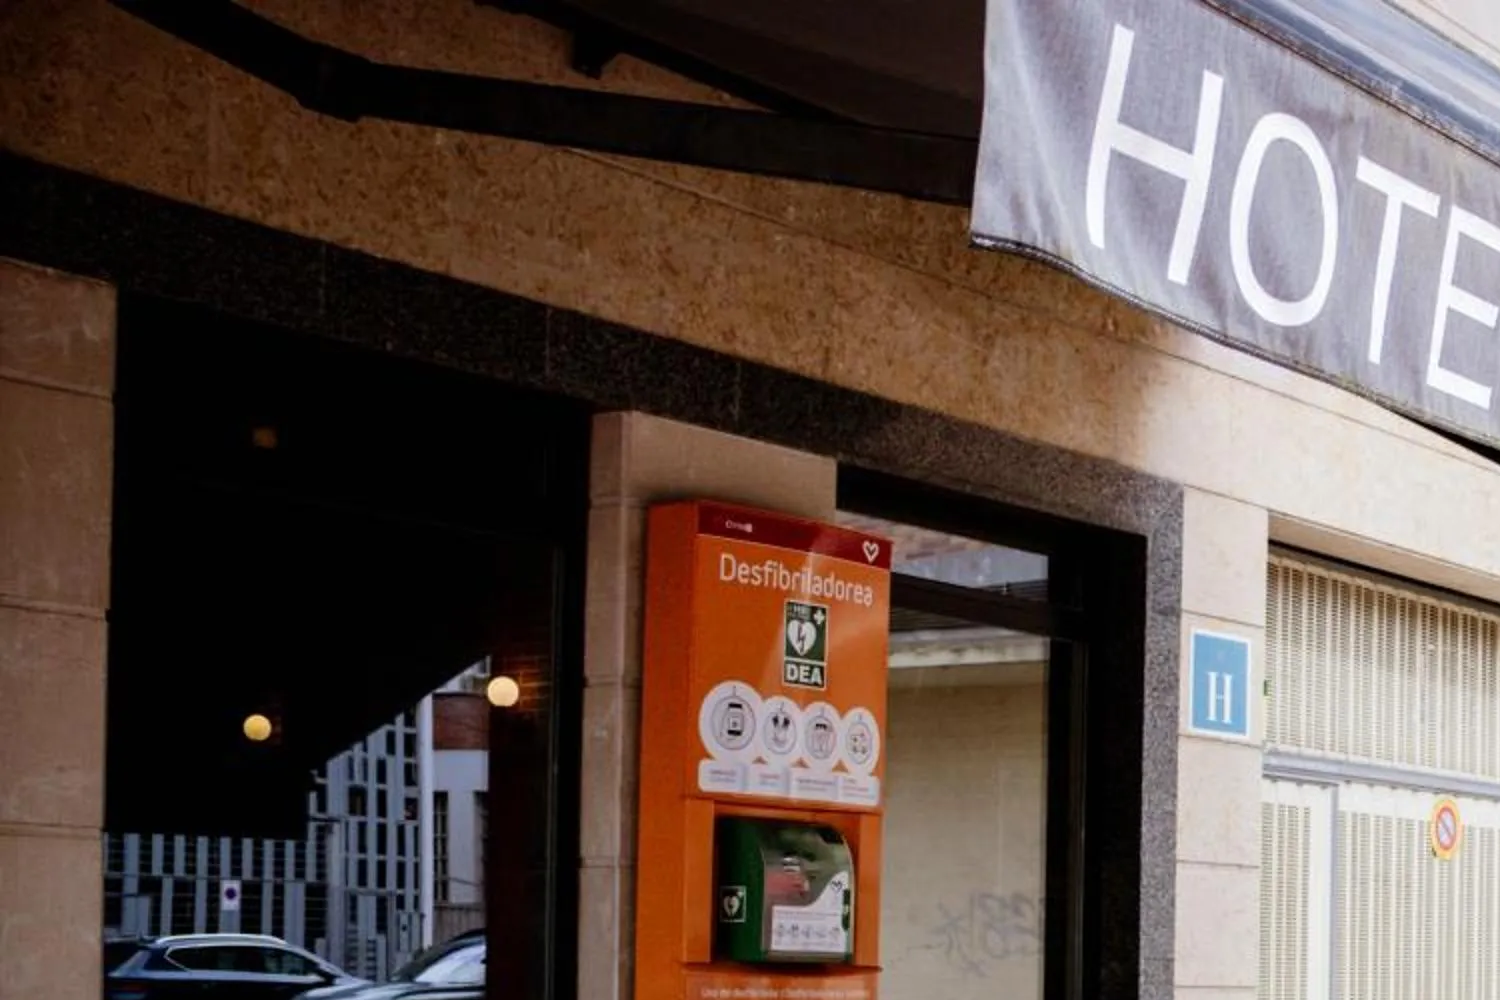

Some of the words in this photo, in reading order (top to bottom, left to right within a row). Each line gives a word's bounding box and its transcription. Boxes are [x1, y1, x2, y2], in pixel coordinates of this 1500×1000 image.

[719, 552, 874, 608] Desfibriladorea
[786, 663, 823, 686] DEA
[1206, 671, 1233, 724] H
